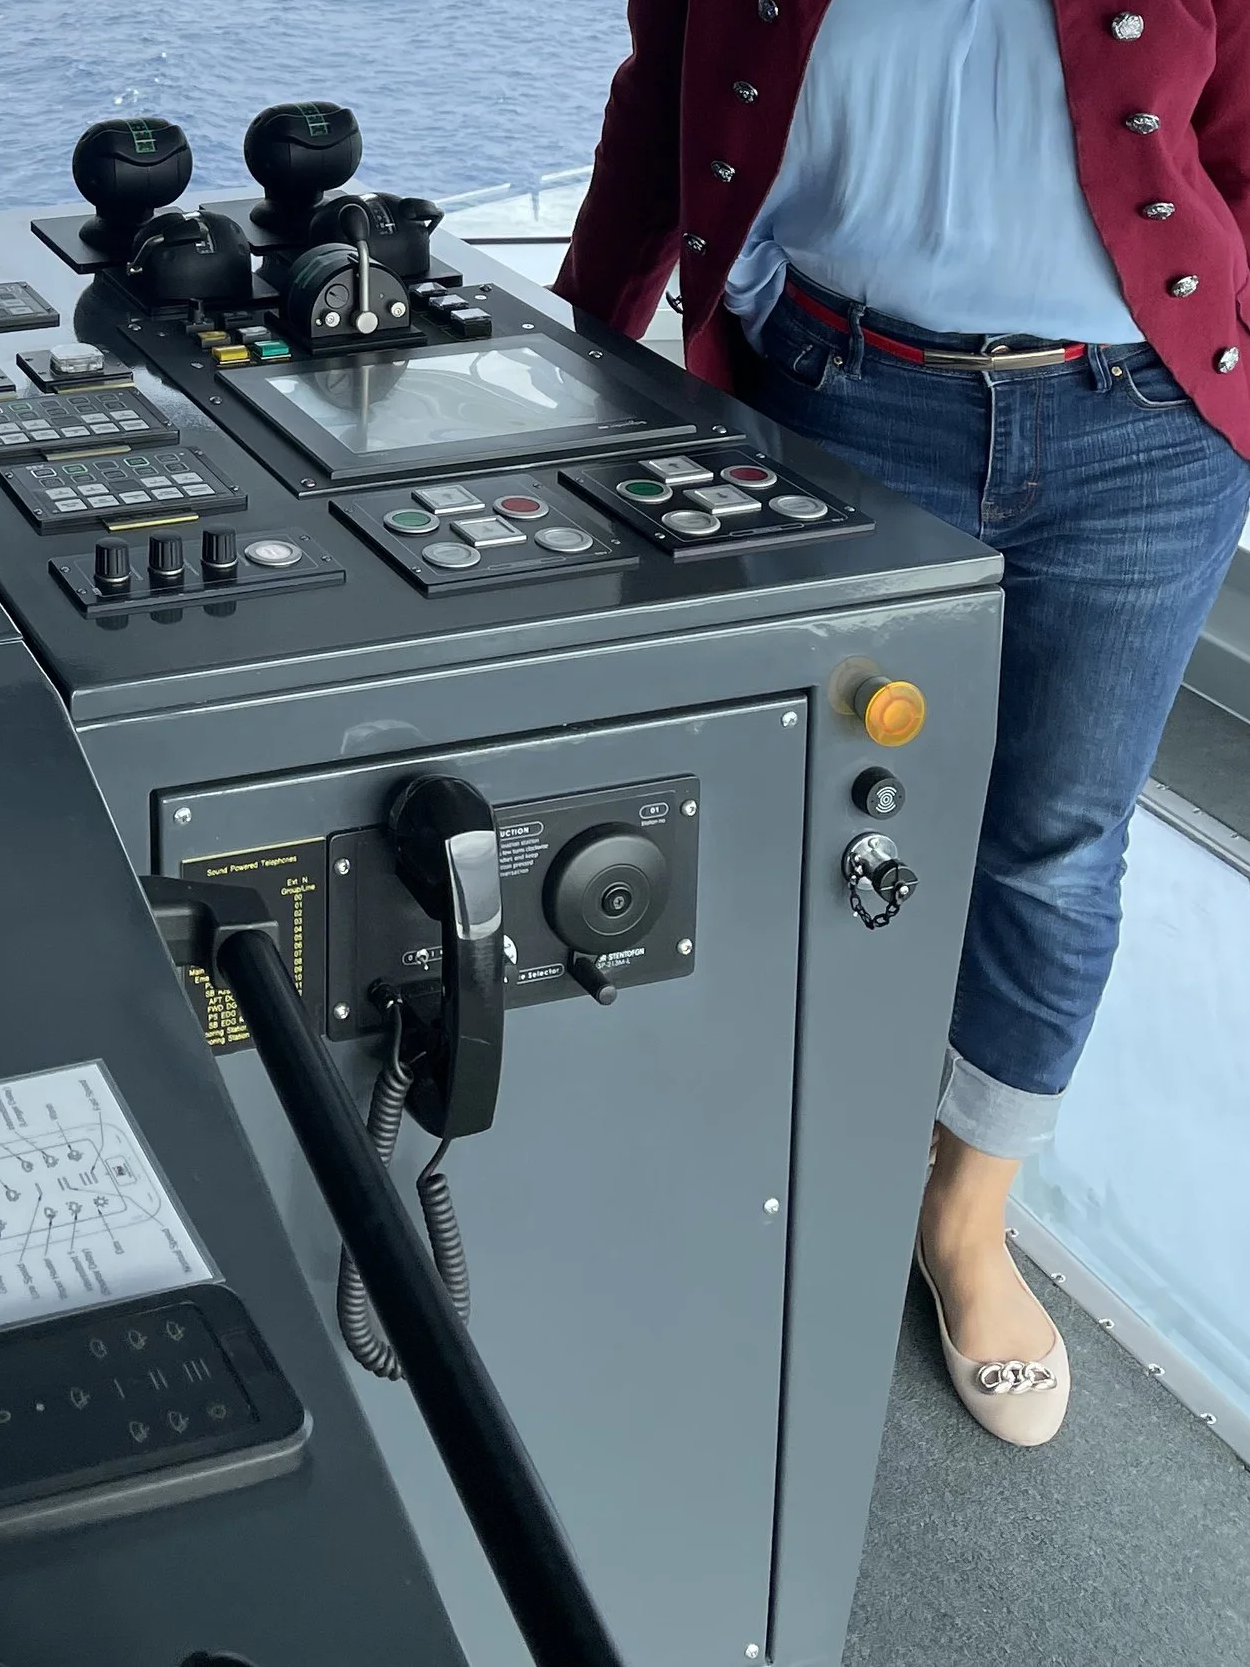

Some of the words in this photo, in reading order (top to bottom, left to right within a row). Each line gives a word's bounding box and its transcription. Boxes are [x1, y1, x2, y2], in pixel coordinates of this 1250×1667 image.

[650, 806, 660, 814] 01
[207, 867, 228, 876] Sound
[230, 861, 258, 872] Powered
